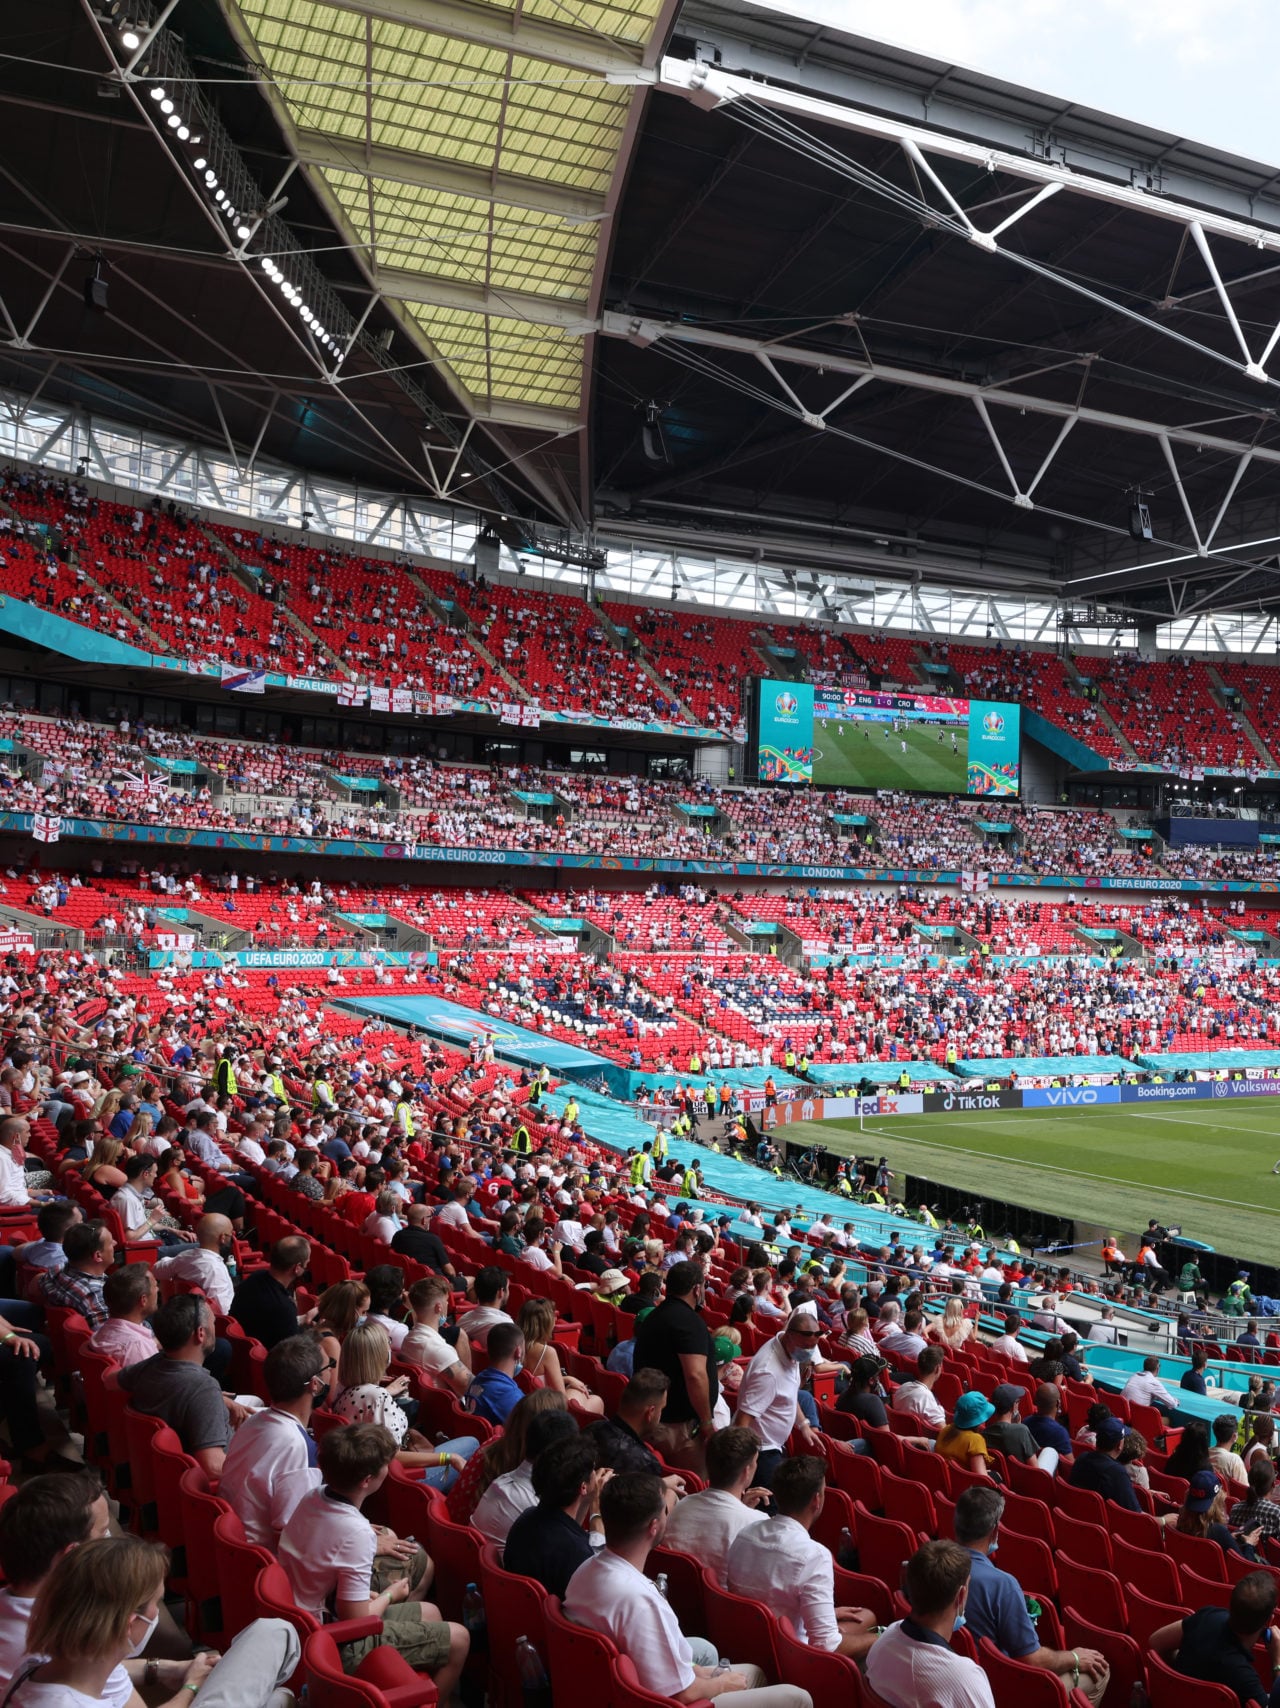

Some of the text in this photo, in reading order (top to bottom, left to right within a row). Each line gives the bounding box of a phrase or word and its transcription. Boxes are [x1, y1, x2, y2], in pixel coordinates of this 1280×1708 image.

[312, 681, 338, 693] EURO
[822, 693, 841, 701] 90:00
[858, 696, 872, 705] ENG
[897, 700, 911, 708] CRO
[415, 849, 506, 863] UEFA EURO 2020
[802, 866, 844, 879] LONDON
[1109, 878, 1182, 890] UEFA EURO 2020
[246, 952, 324, 965] UEFA EURO 2020
[1046, 1087, 1098, 1106] vivo
[1137, 1085, 1197, 1099] Booking.com
[854, 1096, 899, 1116] FedEx
[957, 1096, 1001, 1110] TikTok
[488, 1182, 499, 1196] 6
